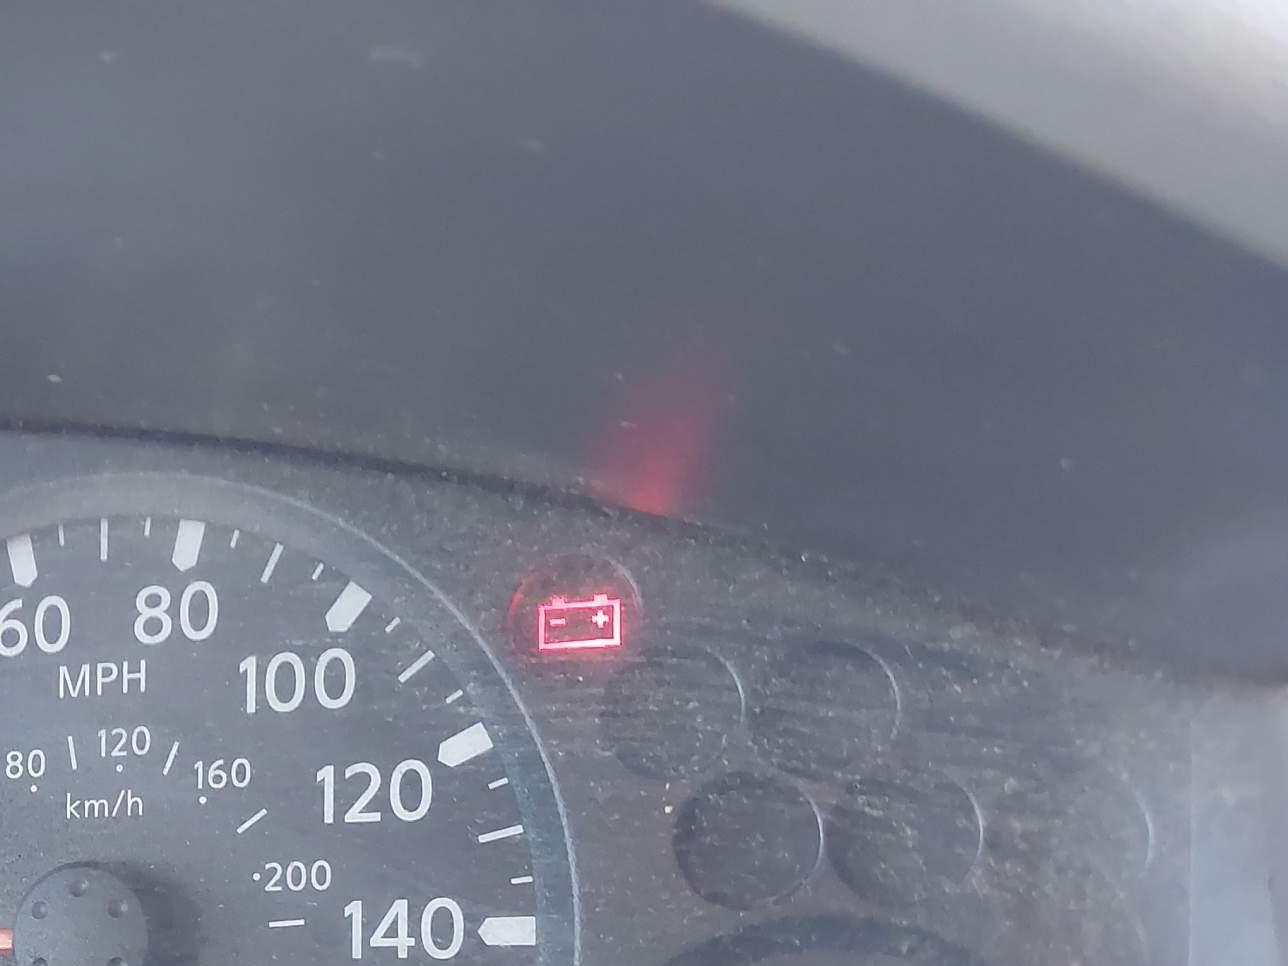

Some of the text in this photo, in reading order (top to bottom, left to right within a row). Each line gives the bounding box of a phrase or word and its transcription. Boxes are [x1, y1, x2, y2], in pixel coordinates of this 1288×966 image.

[132, 580, 219, 645] 80
[57, 660, 148, 699] MPH
[238, 647, 357, 714] 100
[97, 725, 152, 758] 120
[4, 748, 47, 781] 80
[193, 757, 253, 790] 160
[65, 790, 145, 820] km/h
[315, 758, 433, 825] 120
[263, 859, 333, 893] 200
[342, 896, 465, 960] 140
